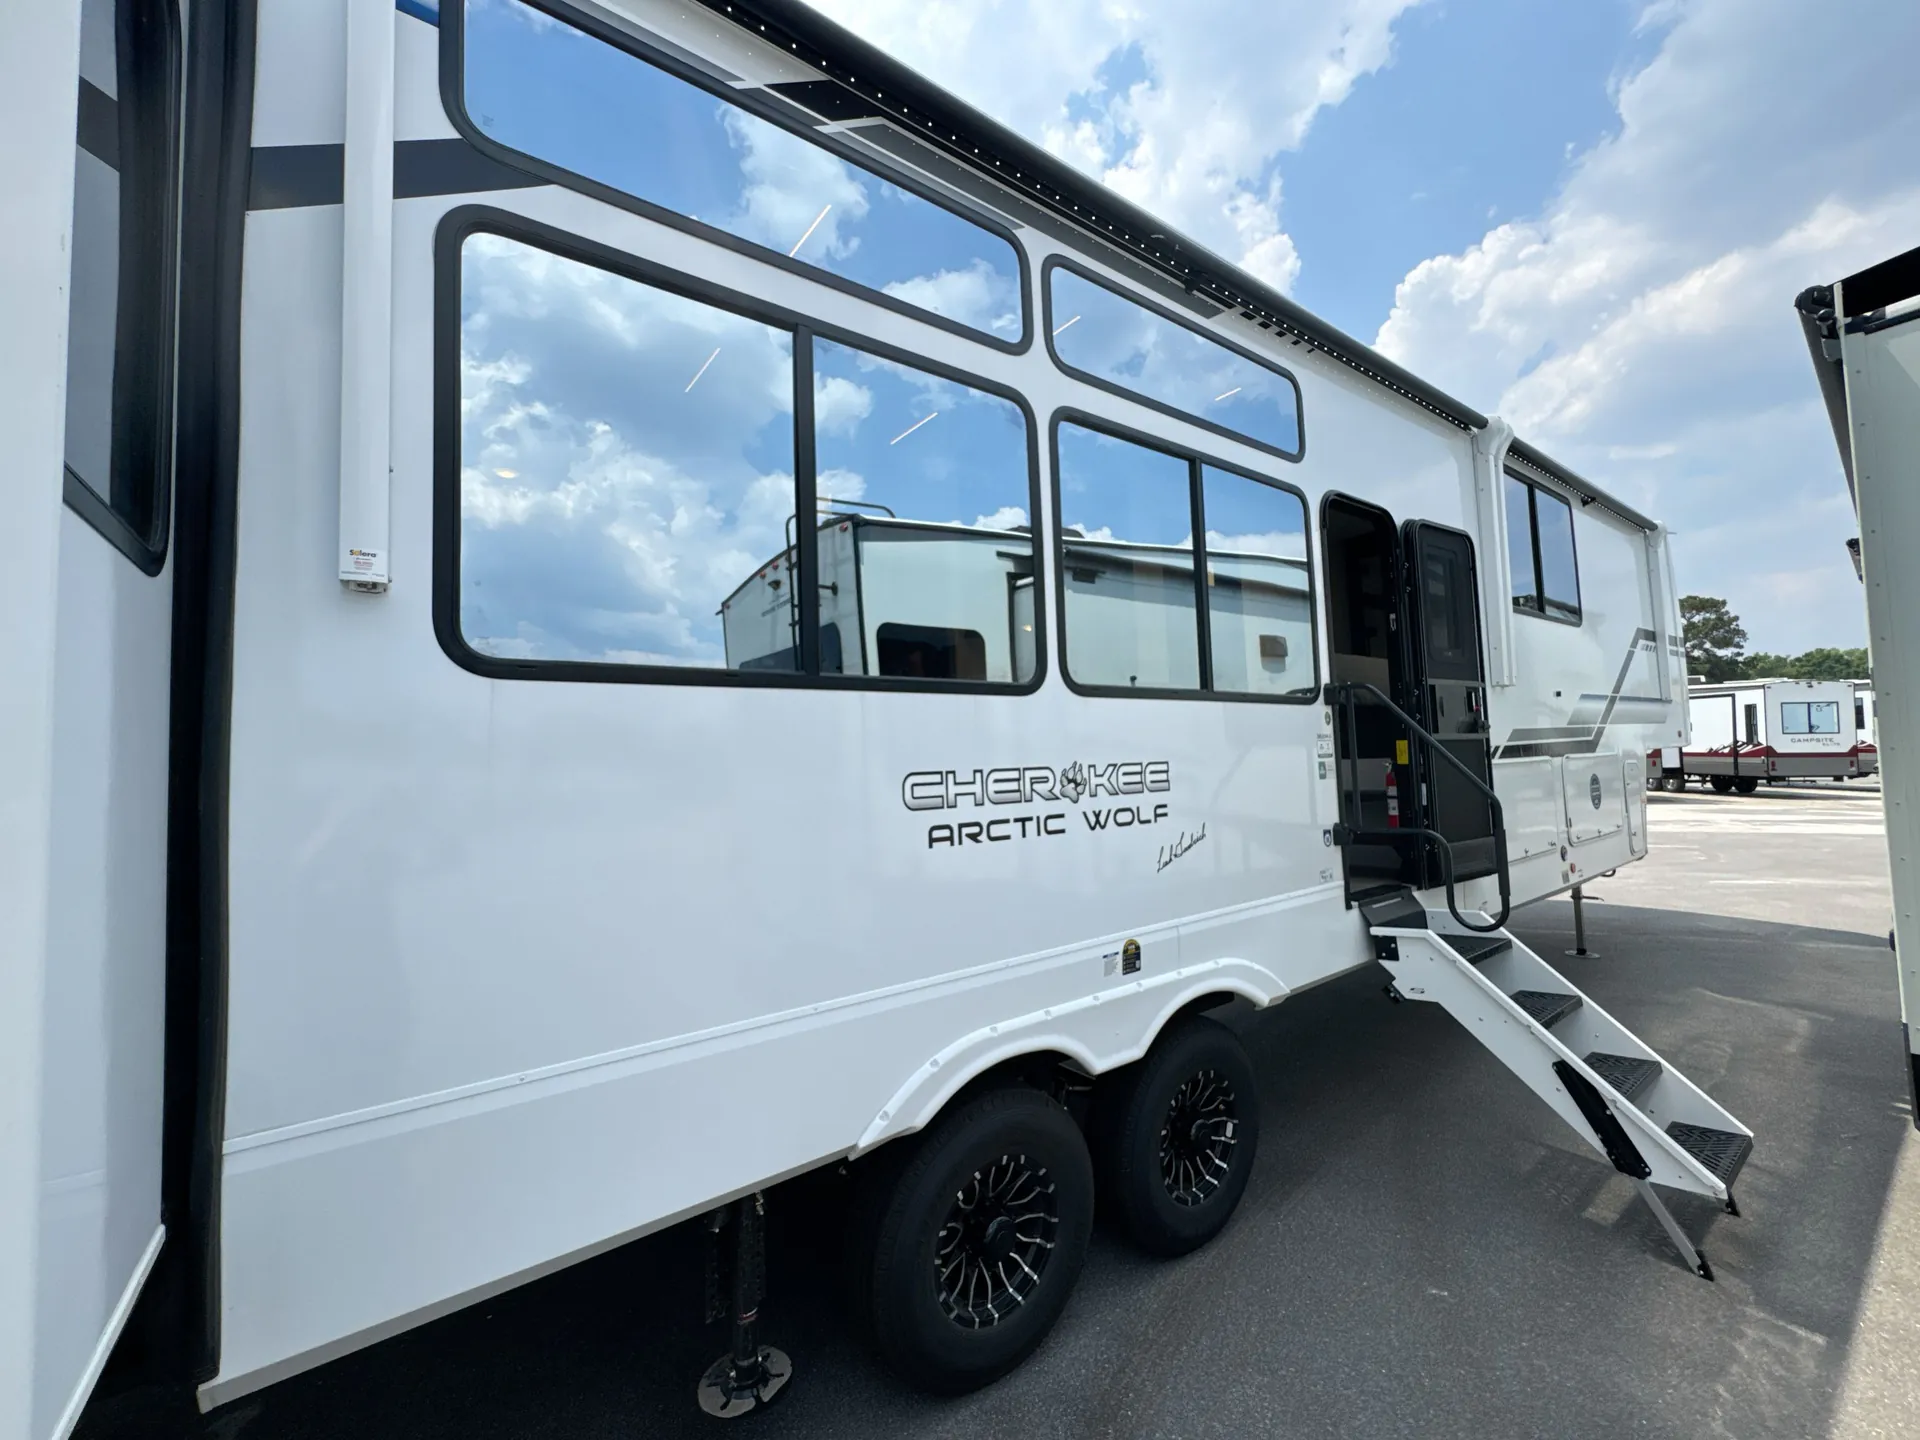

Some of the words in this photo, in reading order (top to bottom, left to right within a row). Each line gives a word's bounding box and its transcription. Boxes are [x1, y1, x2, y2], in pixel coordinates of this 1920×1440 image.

[901, 760, 1171, 812] CHERKEE
[927, 813, 1066, 850] ARCTIC
[1082, 803, 1169, 832] WOLF
